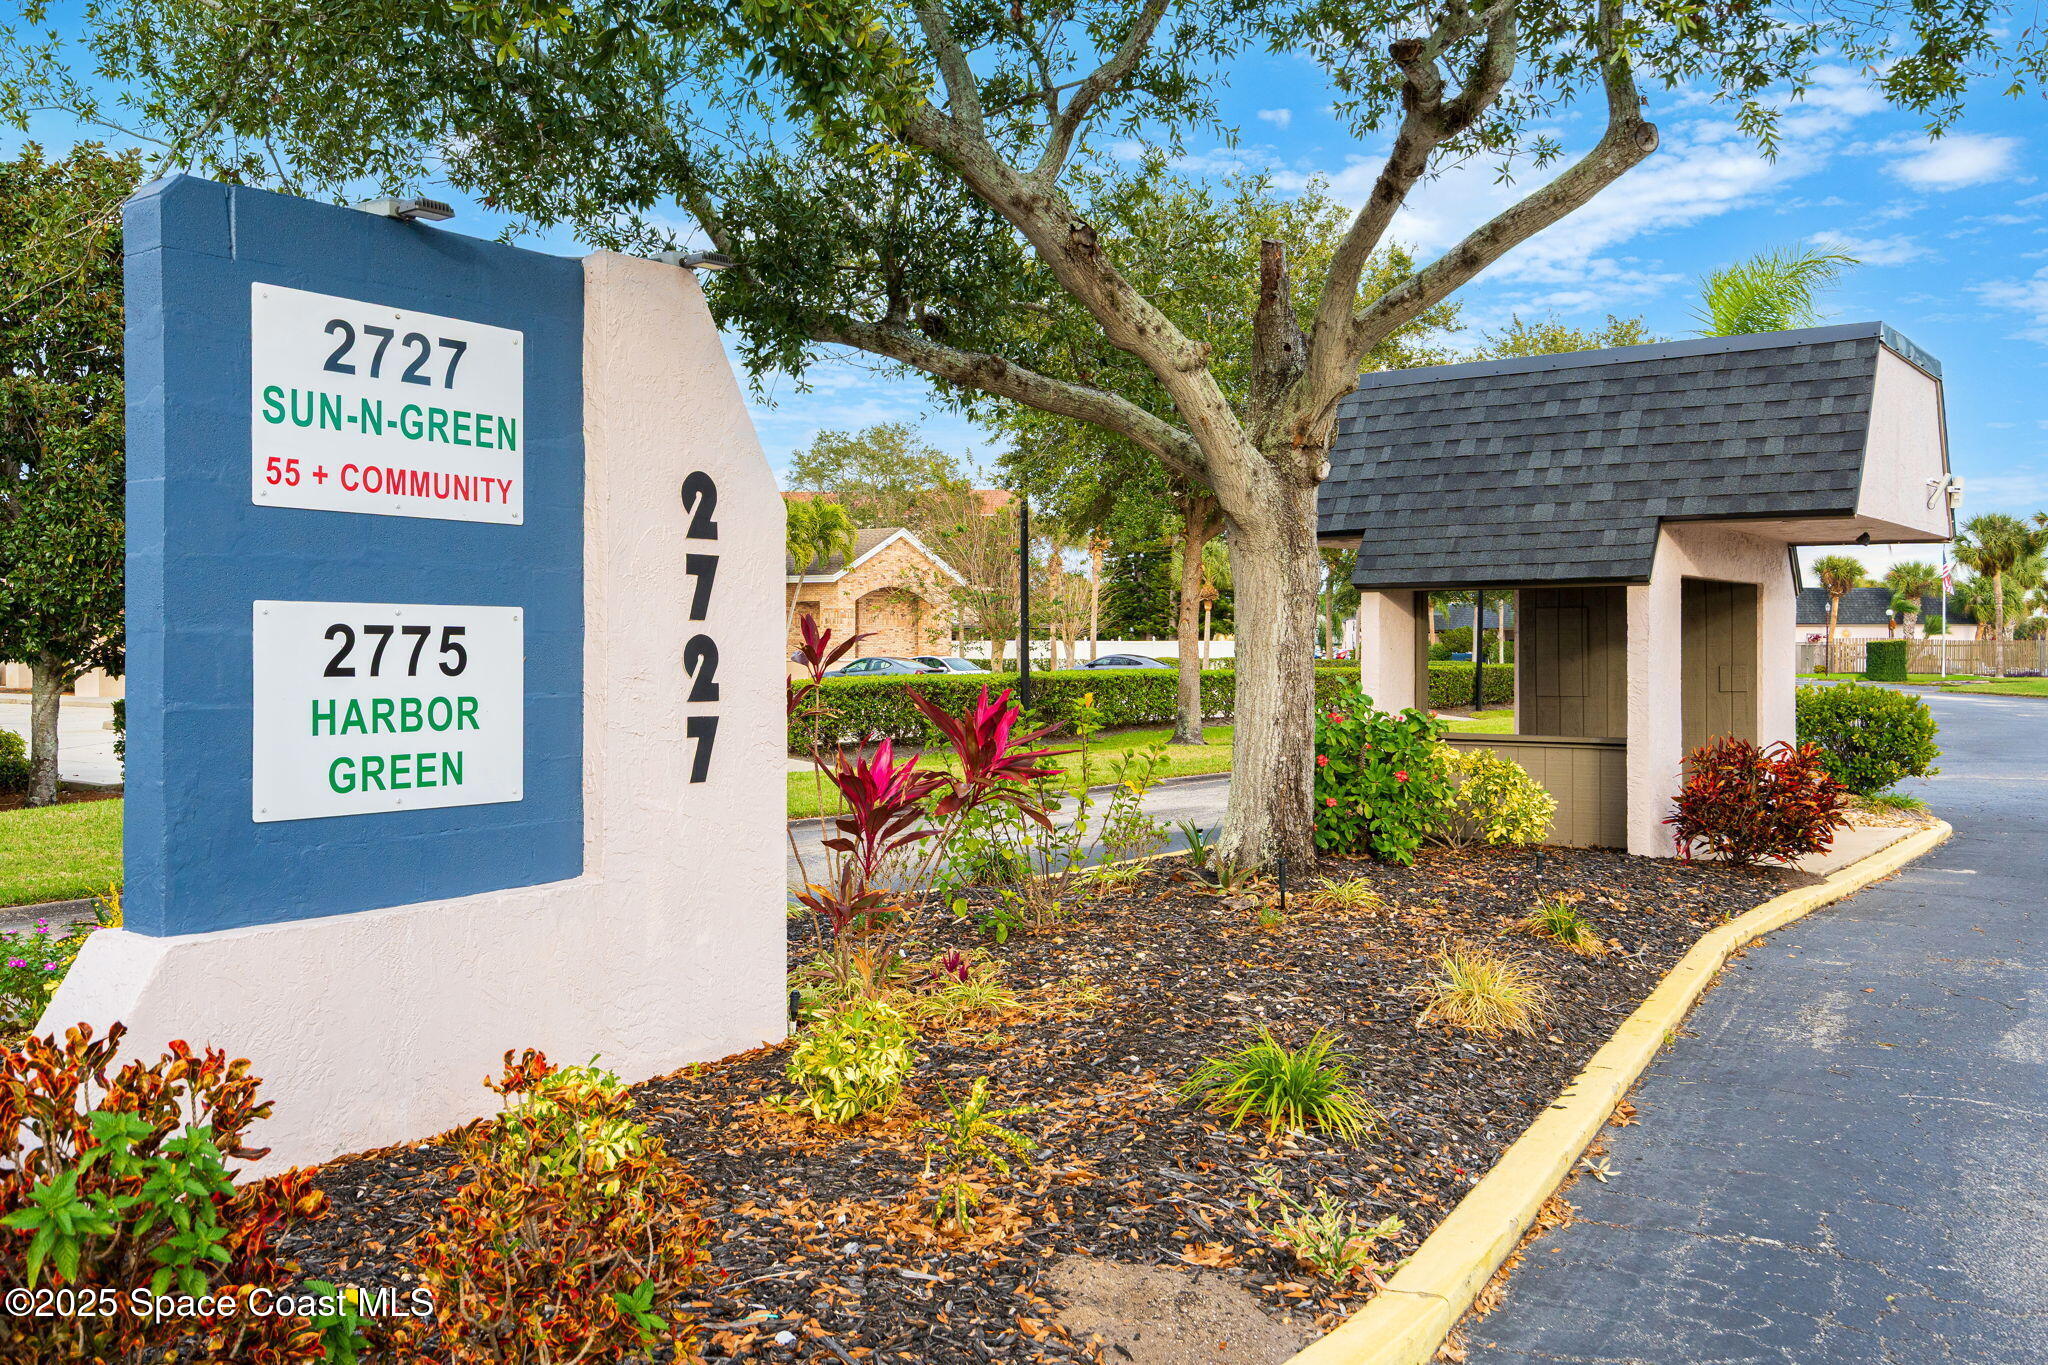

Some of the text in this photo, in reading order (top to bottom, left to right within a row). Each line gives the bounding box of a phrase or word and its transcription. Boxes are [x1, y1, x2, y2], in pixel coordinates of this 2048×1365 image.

[323, 318, 468, 390] 2727
[262, 384, 517, 452] SUN-N-GREEN
[265, 456, 301, 487] 55
[340, 463, 514, 505] COMMUNITY
[323, 622, 468, 678] 2775
[681, 470, 721, 784] 2727
[311, 696, 480, 737] HARBOR
[328, 750, 464, 795] GREEN
